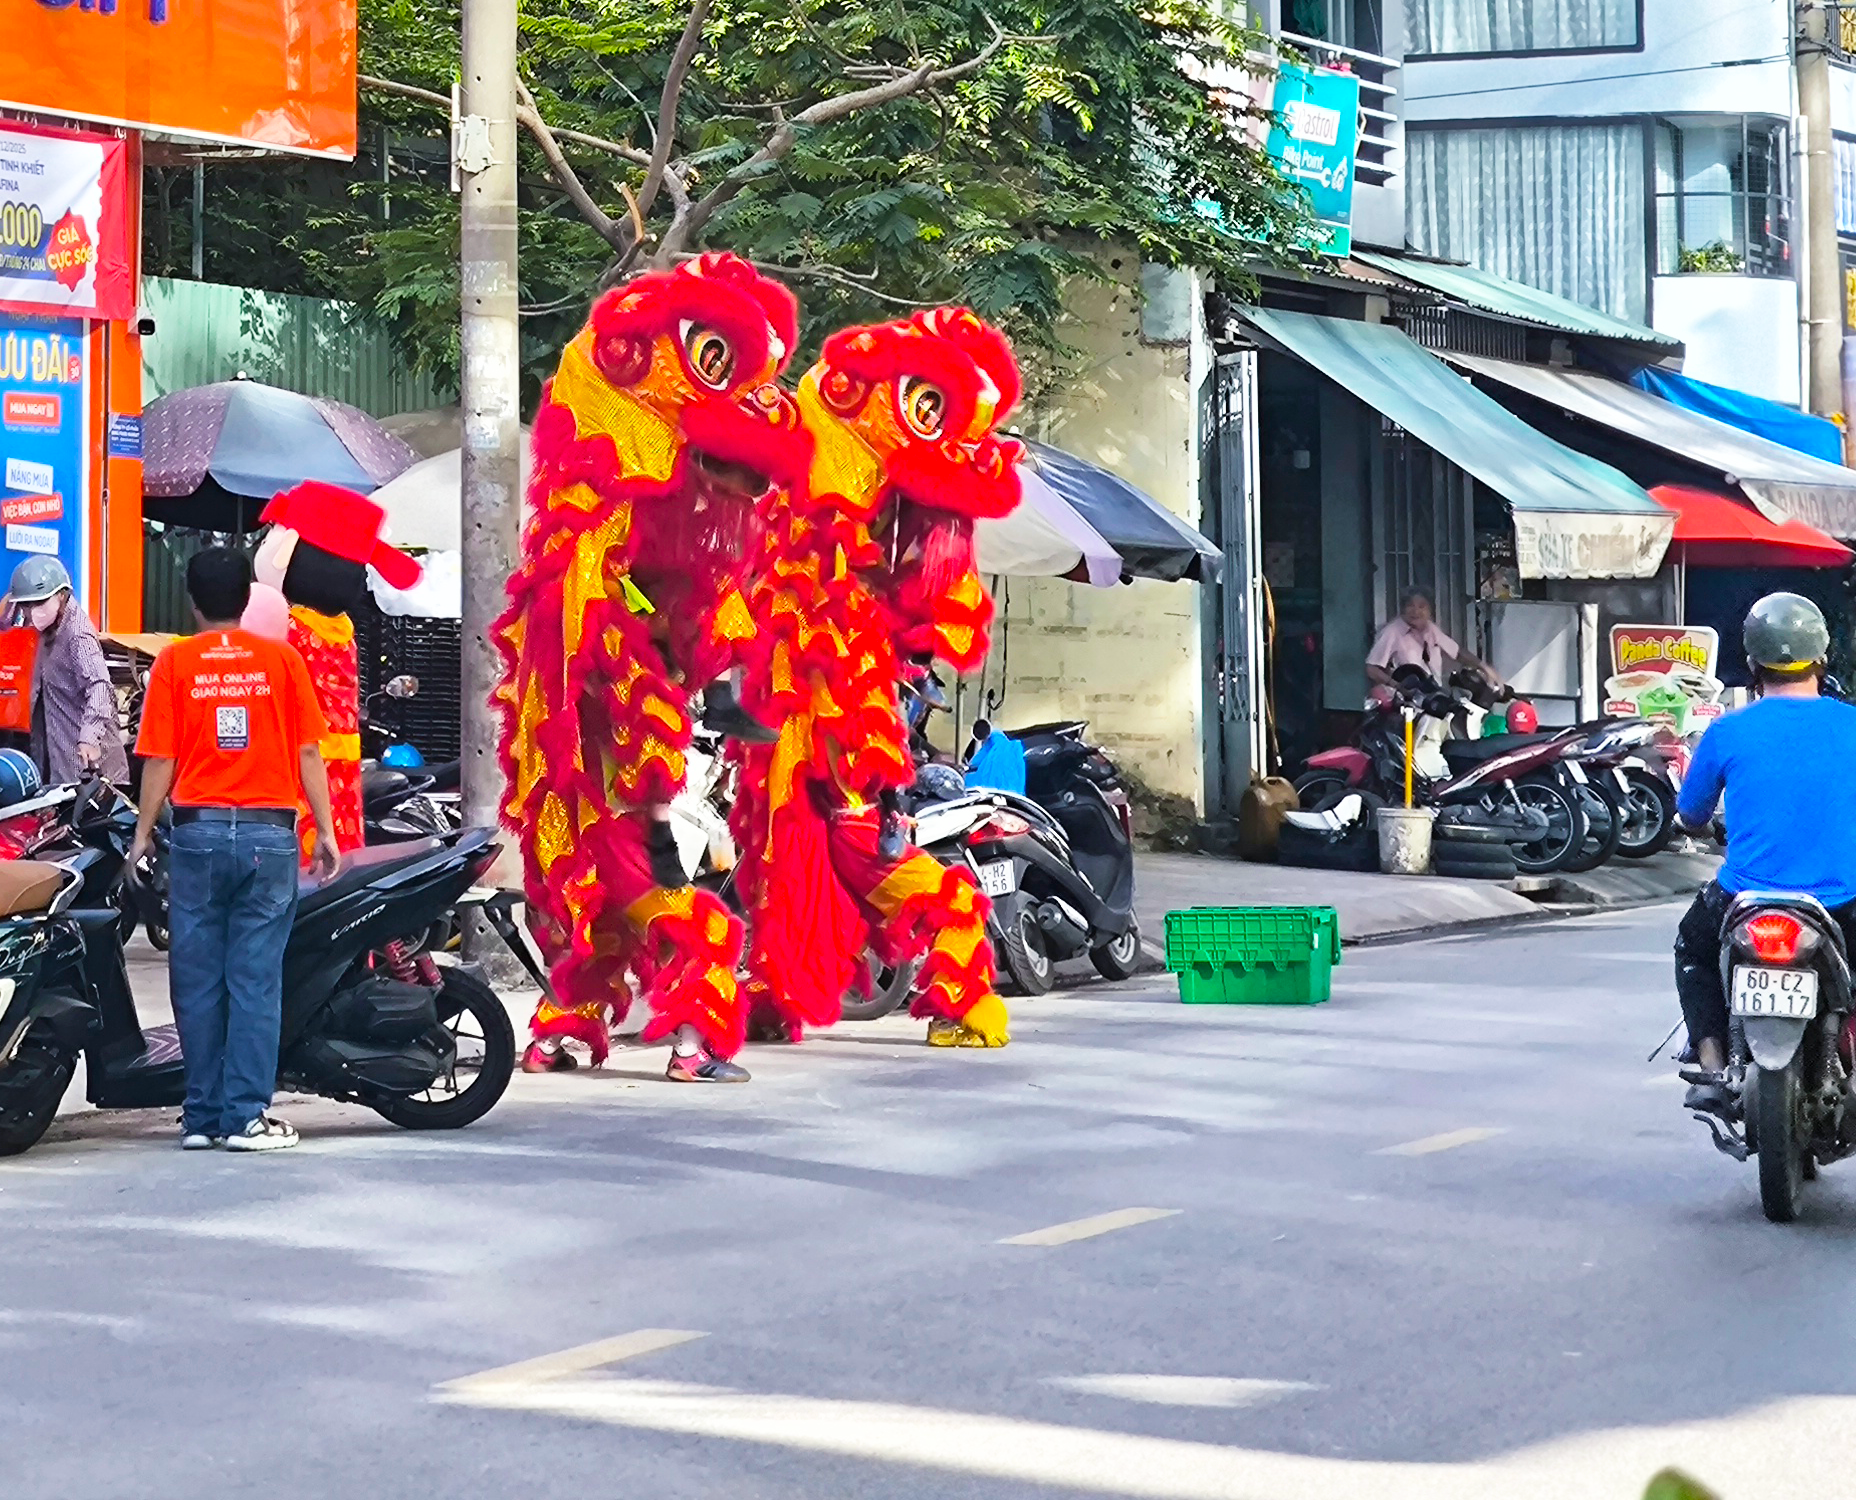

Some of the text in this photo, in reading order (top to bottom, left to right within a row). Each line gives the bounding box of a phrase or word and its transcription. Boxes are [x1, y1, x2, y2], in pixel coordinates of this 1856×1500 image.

[0, 158, 19, 173] TINH
[21, 159, 45, 176] KHIẾT
[1300, 150, 1325, 171] Point
[57, 223, 81, 245] GIÁ
[47, 241, 95, 273] CỰC SỐC
[31, 333, 69, 383] ĐÃI
[10, 468, 50, 489] NẮNG MƯA
[24, 533, 34, 546] RA
[1619, 636, 1708, 672] Panda Coffee
[195, 672, 266, 685] MUA ONLINE
[191, 684, 270, 699] GIAO NGAY 2H
[1740, 991, 1810, 1015] 161.17
